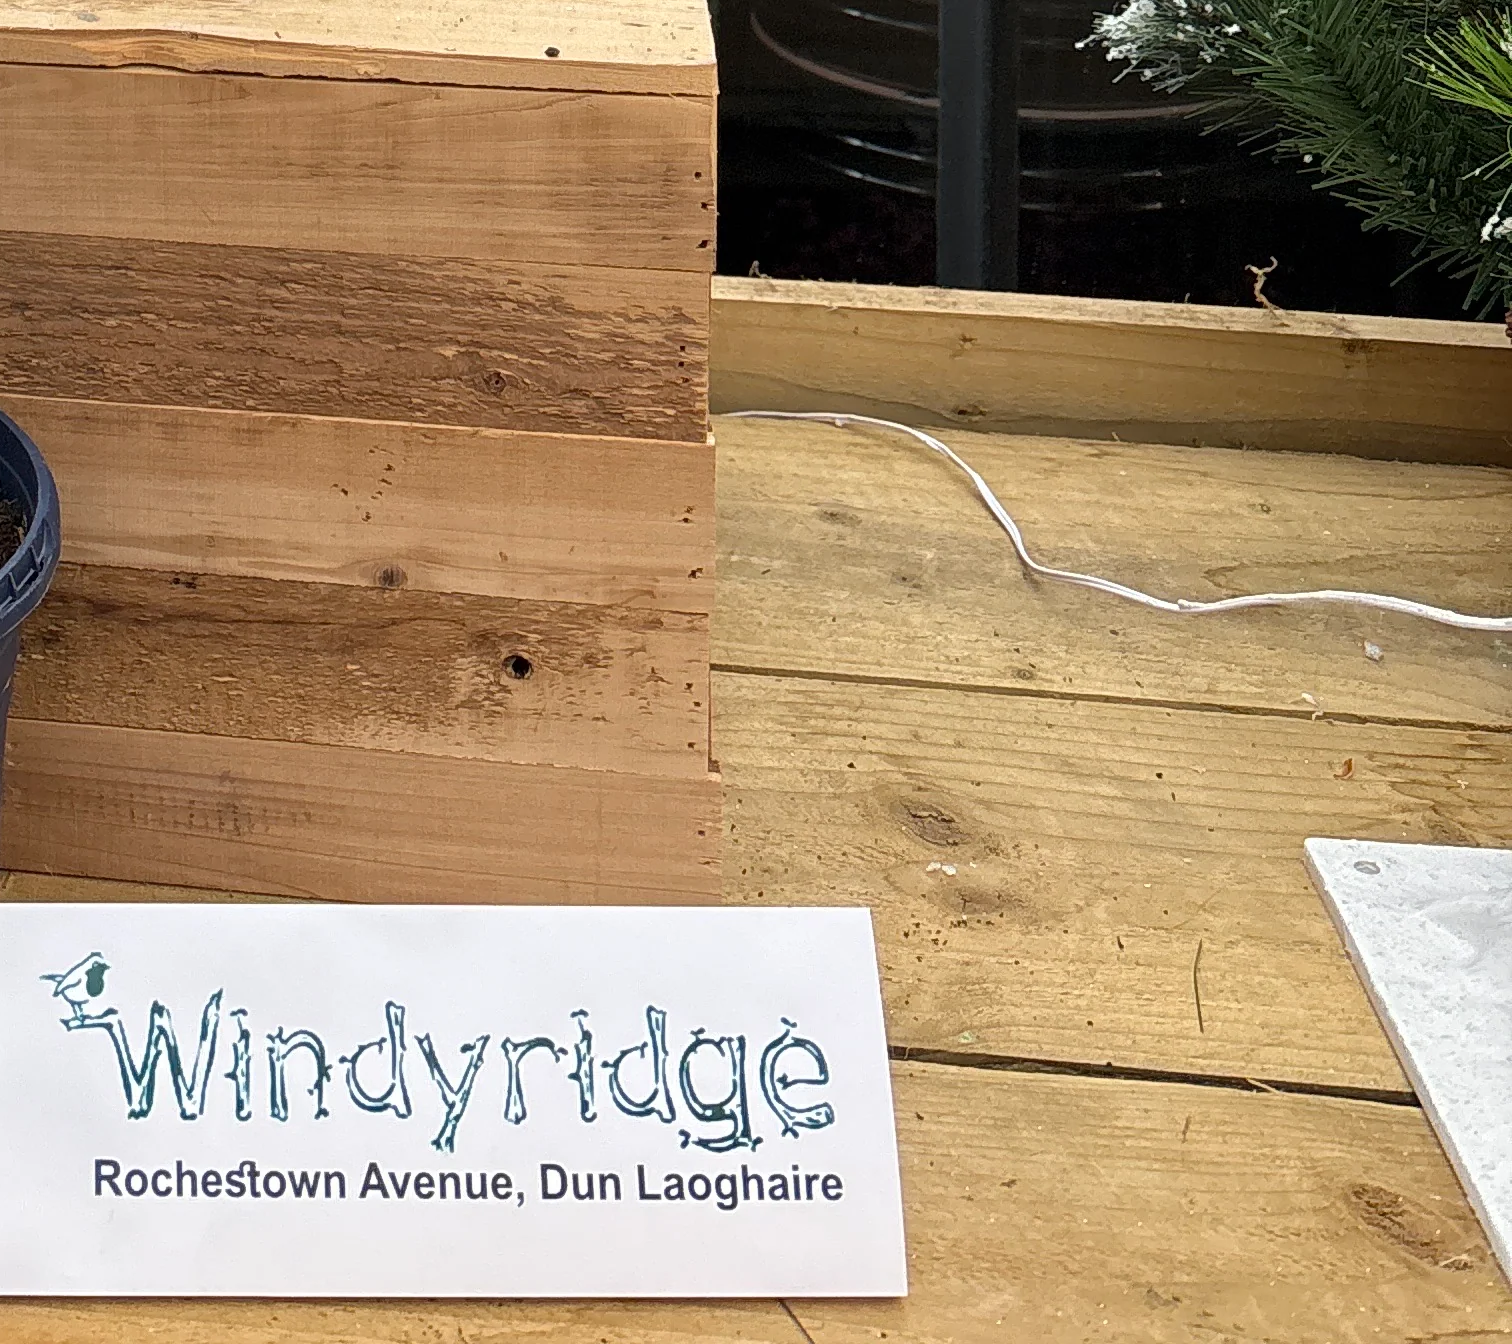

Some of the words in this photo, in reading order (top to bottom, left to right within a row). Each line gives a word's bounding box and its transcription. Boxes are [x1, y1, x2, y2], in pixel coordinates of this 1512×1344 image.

[61, 989, 835, 1153] Windyridge
[93, 1159, 347, 1201] Rochestown
[359, 1161, 525, 1209] Avenue,
[541, 1163, 622, 1202] Dun
[639, 1163, 844, 1210] Laoghaire
